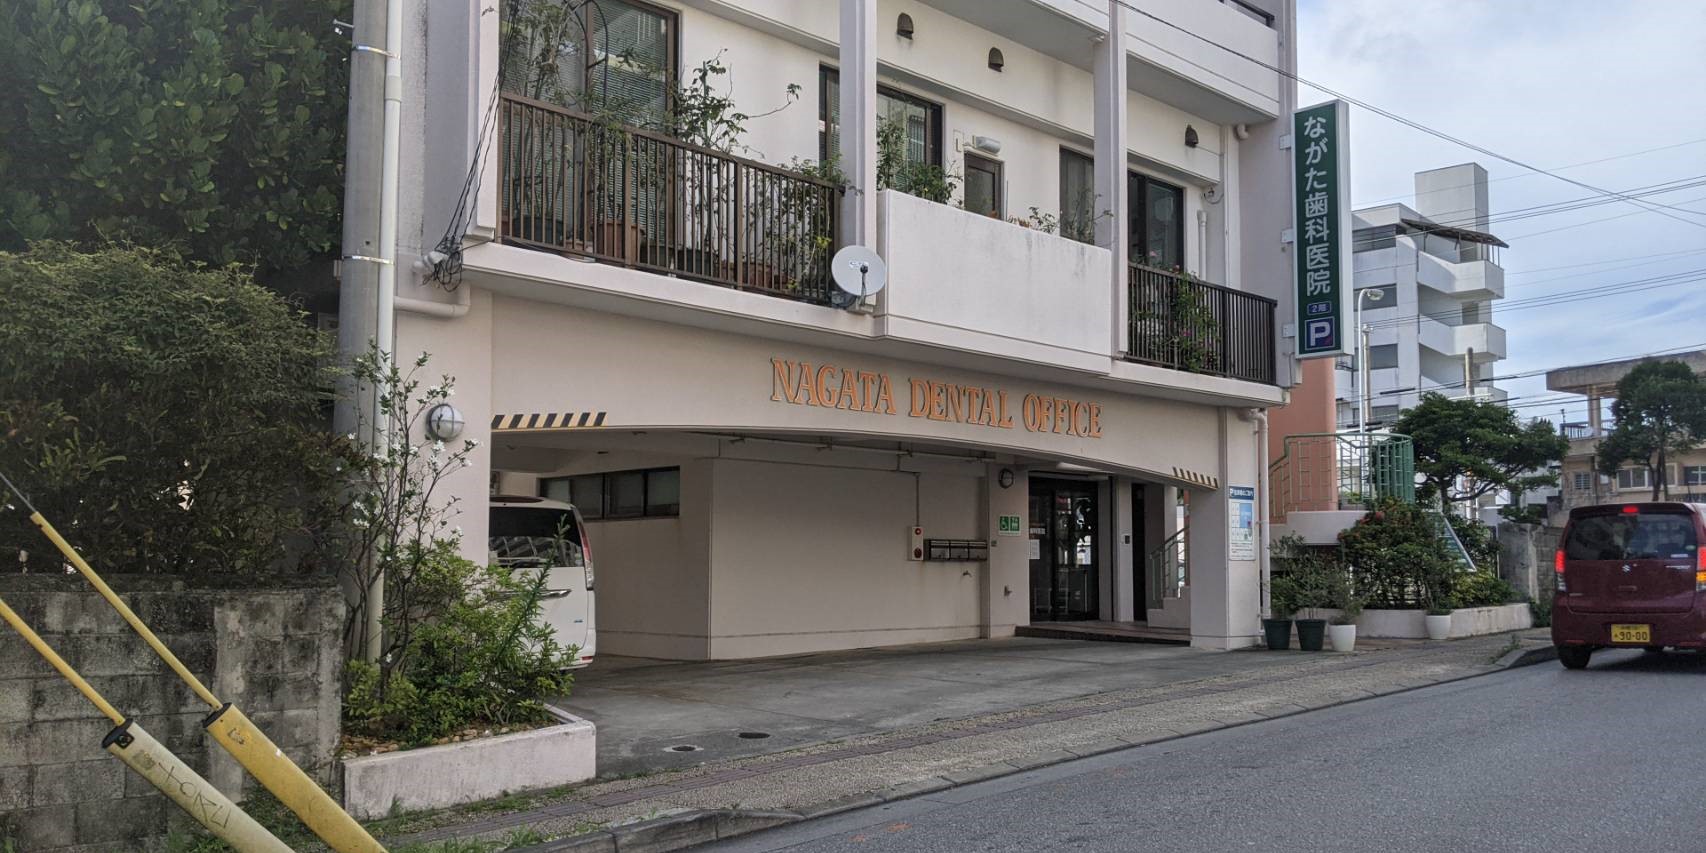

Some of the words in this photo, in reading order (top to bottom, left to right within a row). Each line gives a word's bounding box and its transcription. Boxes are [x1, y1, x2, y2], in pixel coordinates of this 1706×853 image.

[1304, 116, 1330, 296] ながた歯科医院
[1310, 321, 1332, 346] P
[770, 357, 897, 415] NAGATA
[908, 376, 1016, 429] DENTAL
[1023, 392, 1104, 438] OFFICE
